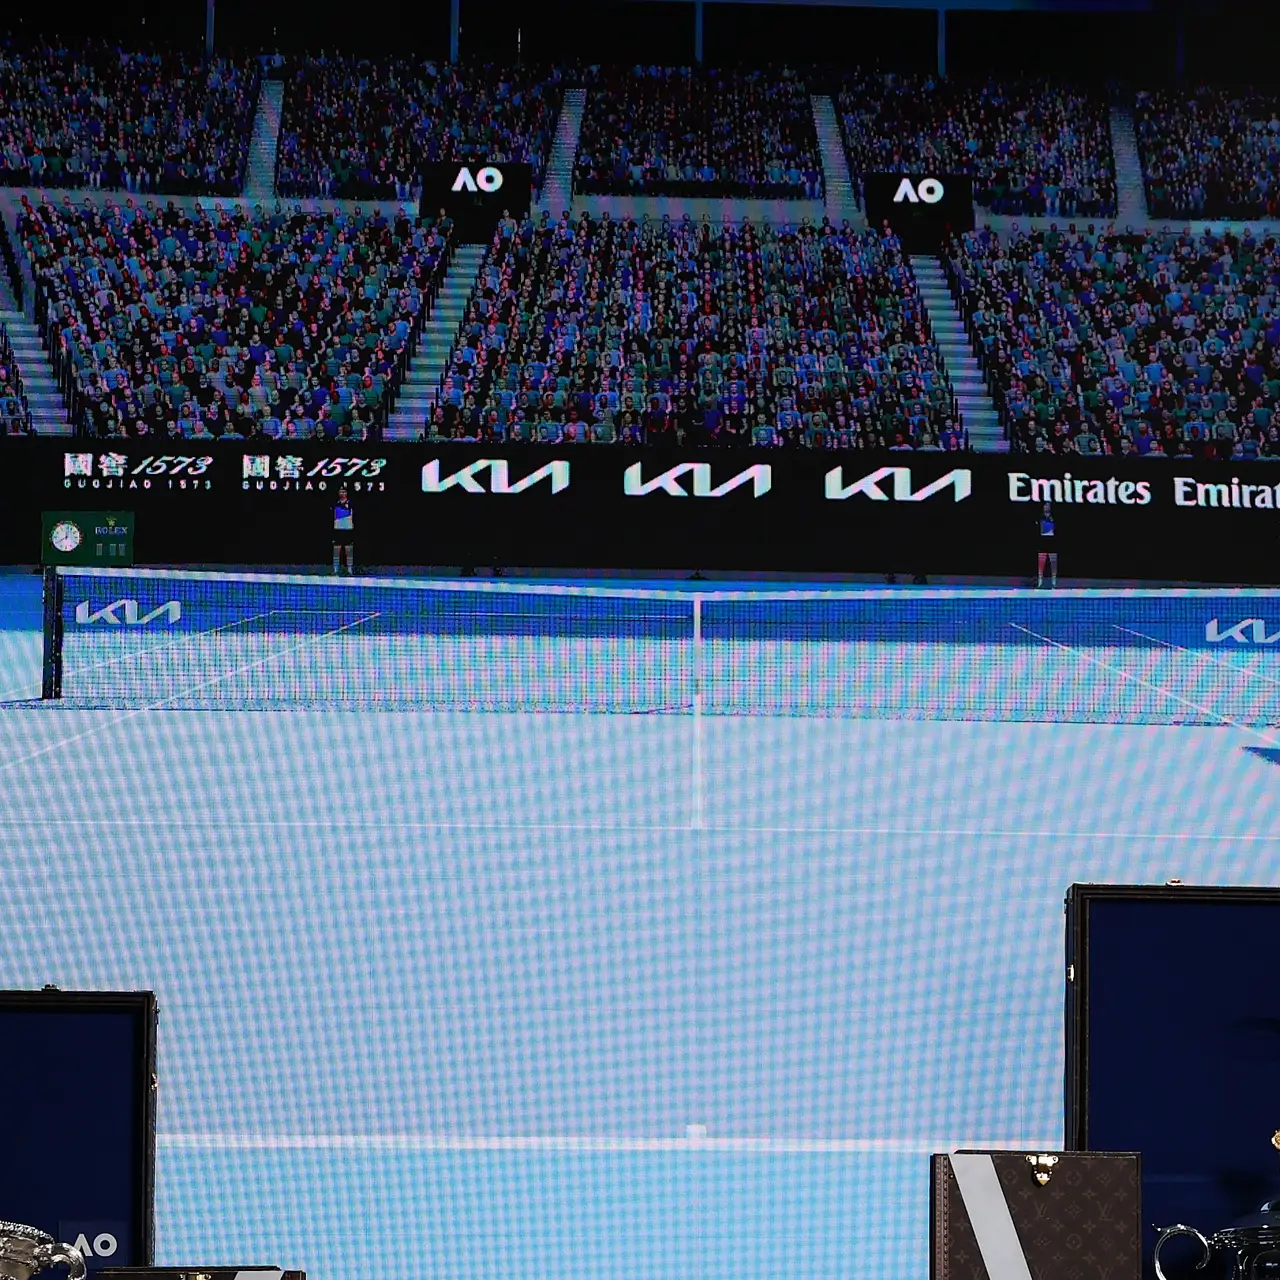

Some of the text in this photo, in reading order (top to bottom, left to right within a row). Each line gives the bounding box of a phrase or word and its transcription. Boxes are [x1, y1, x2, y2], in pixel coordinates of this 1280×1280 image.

[451, 166, 504, 193] AO
[893, 178, 945, 204] AO
[130, 455, 214, 476] 1573
[306, 457, 387, 477] 1573
[422, 459, 570, 495] KIA
[623, 462, 772, 498] KIA
[825, 466, 972, 502] KIA
[1008, 473, 1152, 505] Emirates
[95, 526, 128, 535] ROLEX
[75, 598, 181, 625] KIA
